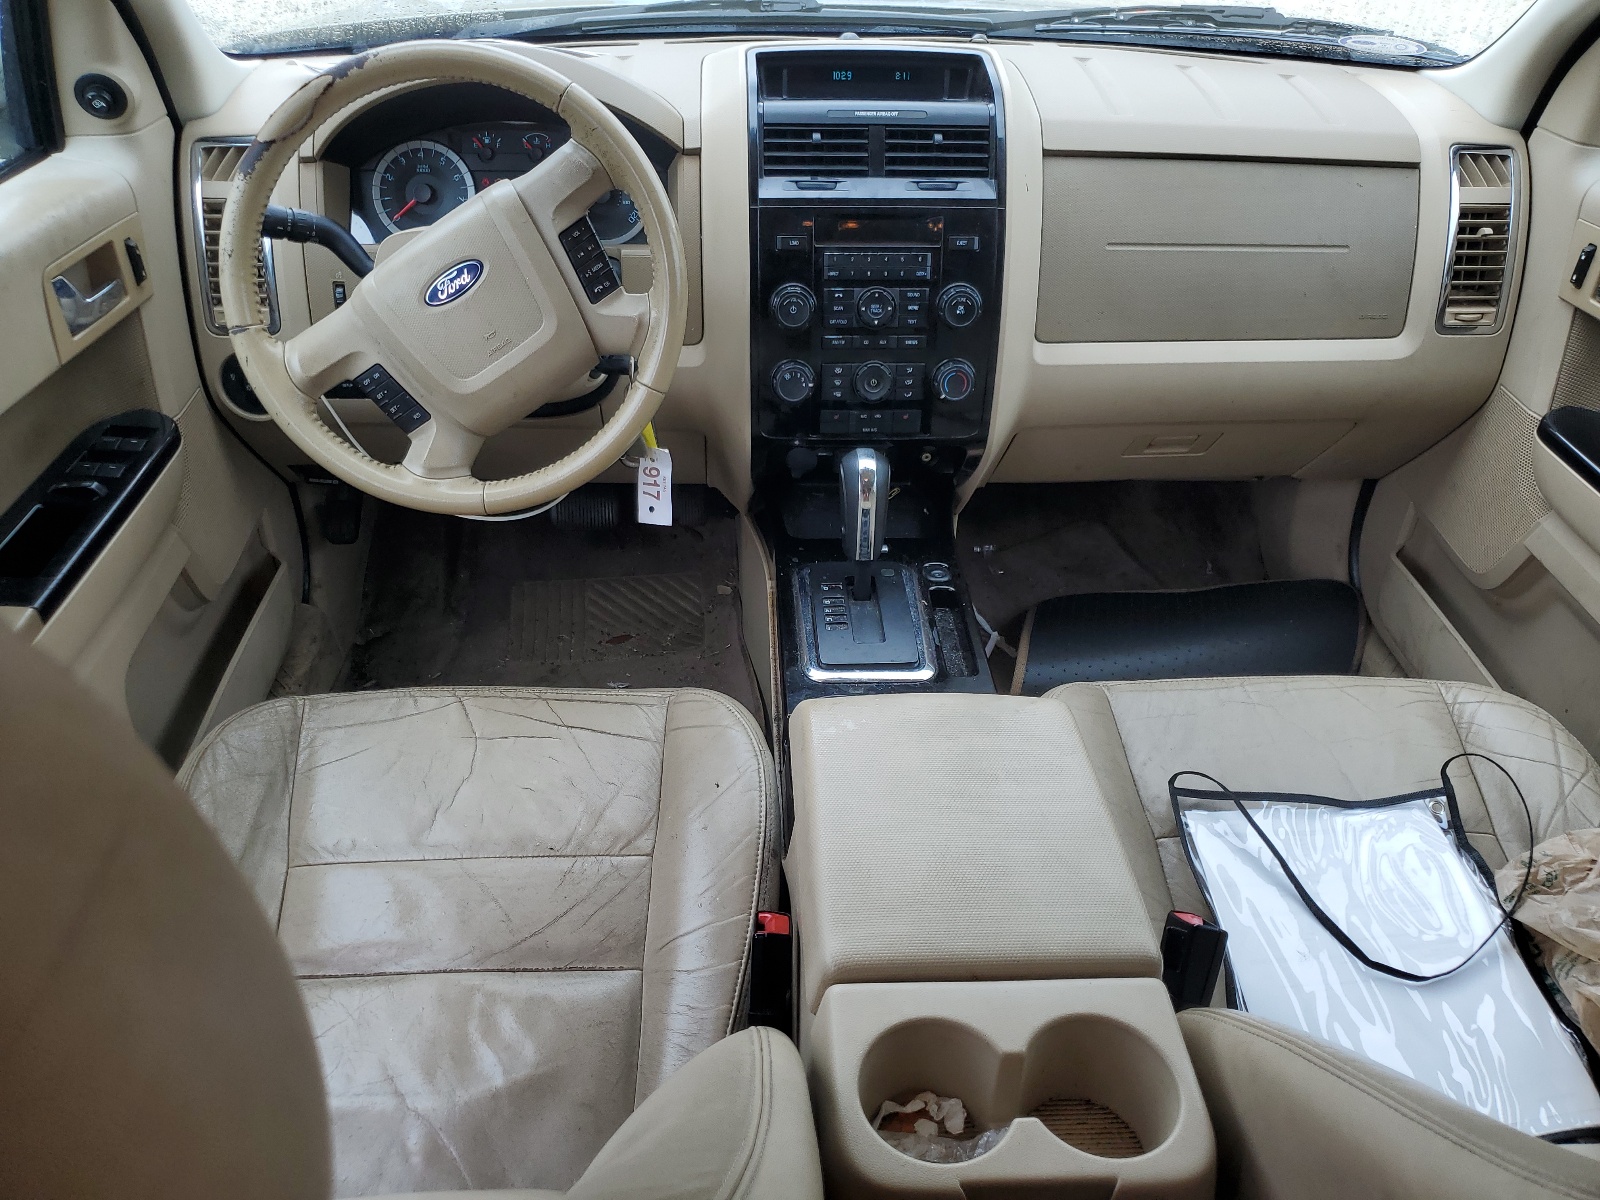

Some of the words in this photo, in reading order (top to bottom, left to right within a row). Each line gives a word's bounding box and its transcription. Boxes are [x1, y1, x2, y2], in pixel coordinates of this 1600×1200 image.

[400, 157, 406, 166] 3
[440, 157, 447, 166] 5
[437, 268, 471, 300] Ford
[363, 378, 371, 386] OFF
[642, 466, 661, 501] 917
